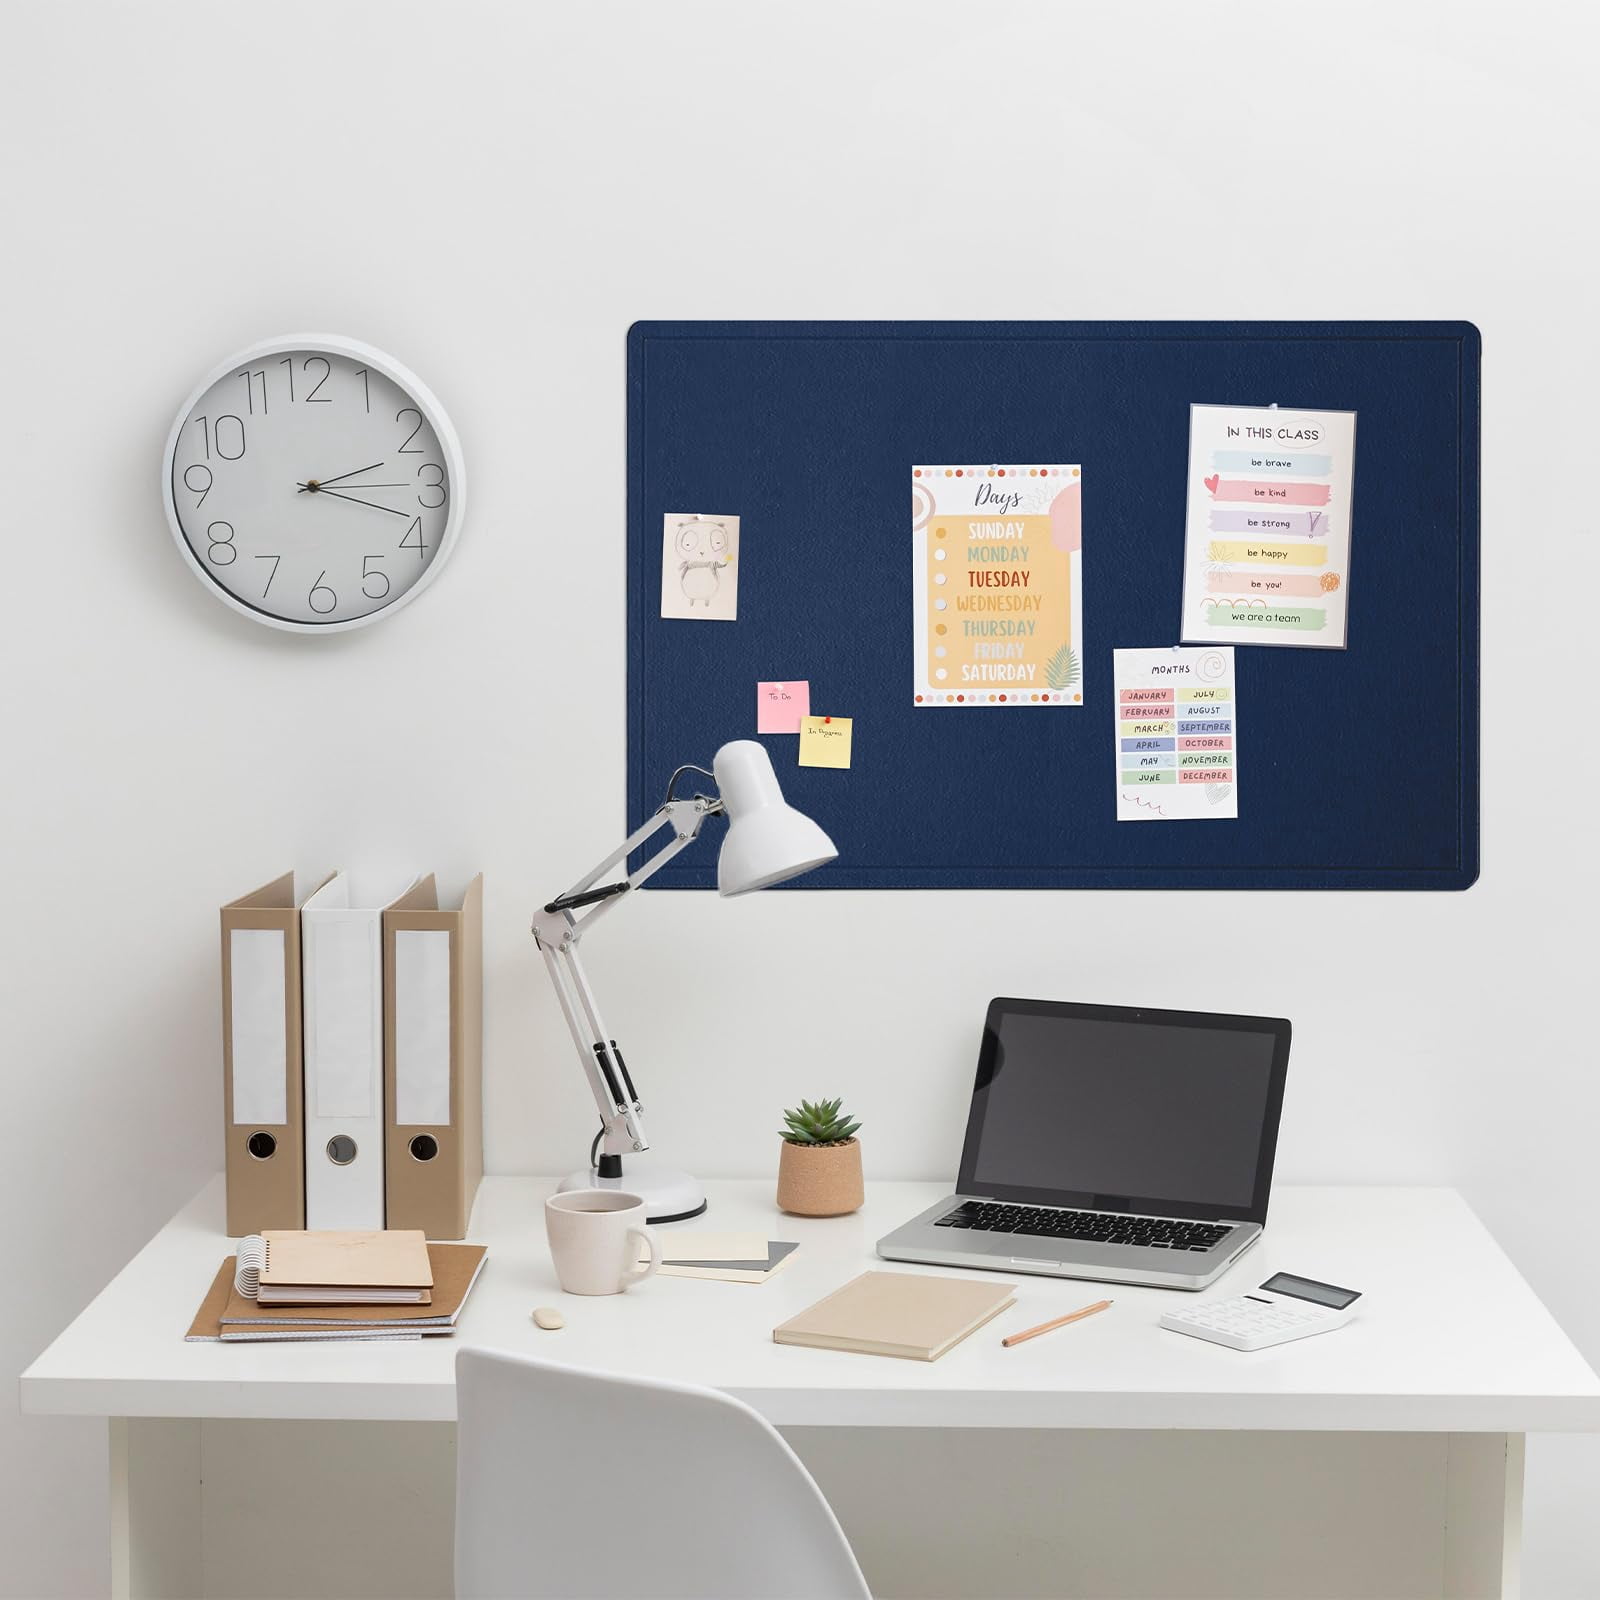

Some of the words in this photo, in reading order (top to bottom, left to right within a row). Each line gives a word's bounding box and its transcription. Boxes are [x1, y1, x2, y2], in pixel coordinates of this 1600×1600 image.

[280, 357, 333, 402] 12
[238, 370, 268, 415] 11
[355, 369, 370, 413] 1
[195, 414, 246, 461] 10
[396, 408, 424, 454] 2
[1227, 426, 1240, 437] IN
[1246, 427, 1272, 439] THIS
[1278, 429, 1319, 440] CLASS
[1266, 459, 1292, 468] brave
[184, 464, 213, 509] 9
[417, 463, 446, 509] 3
[1254, 488, 1265, 496] be
[1269, 489, 1286, 497] kind
[975, 483, 1023, 515] Days
[969, 523, 1024, 539] SUNDAY
[1248, 519, 1258, 527] be
[1262, 520, 1290, 529] strong
[207, 521, 237, 565] 8
[398, 516, 429, 559] 4
[967, 546, 1029, 562] MONDAY
[1247, 549, 1258, 557] be
[1261, 550, 1288, 559] happy
[254, 555, 281, 598] 7
[362, 555, 390, 599] 5
[968, 571, 1030, 588] TUESDAY
[308, 570, 337, 614] 6
[1251, 580, 1261, 588] be
[1266, 581, 1282, 590] you!
[957, 596, 1042, 611] WEDNESDAY
[1232, 613, 1245, 621] we
[1247, 613, 1263, 621] are
[1266, 614, 1272, 622] a
[1275, 613, 1301, 623] team
[963, 620, 1035, 637] THURSDAY
[974, 643, 1024, 659] FRIDAY
[962, 664, 1036, 681] SATURDAY
[1152, 665, 1190, 674] MONTHS
[1128, 691, 1166, 699] JANUARY
[1193, 690, 1214, 698] JULY
[1126, 708, 1169, 716] FEBRUARY
[1188, 707, 1220, 715] AUGUST
[1134, 724, 1163, 732] MARCH
[1181, 723, 1230, 731] SEPTEMBER
[1136, 741, 1160, 749] APRIL
[1185, 739, 1224, 747] OCTOBER
[1141, 757, 1158, 765] MAY
[1183, 756, 1228, 764] NOVEMBER
[1139, 773, 1160, 781] JUNE
[1183, 772, 1227, 780] DECEMBER
